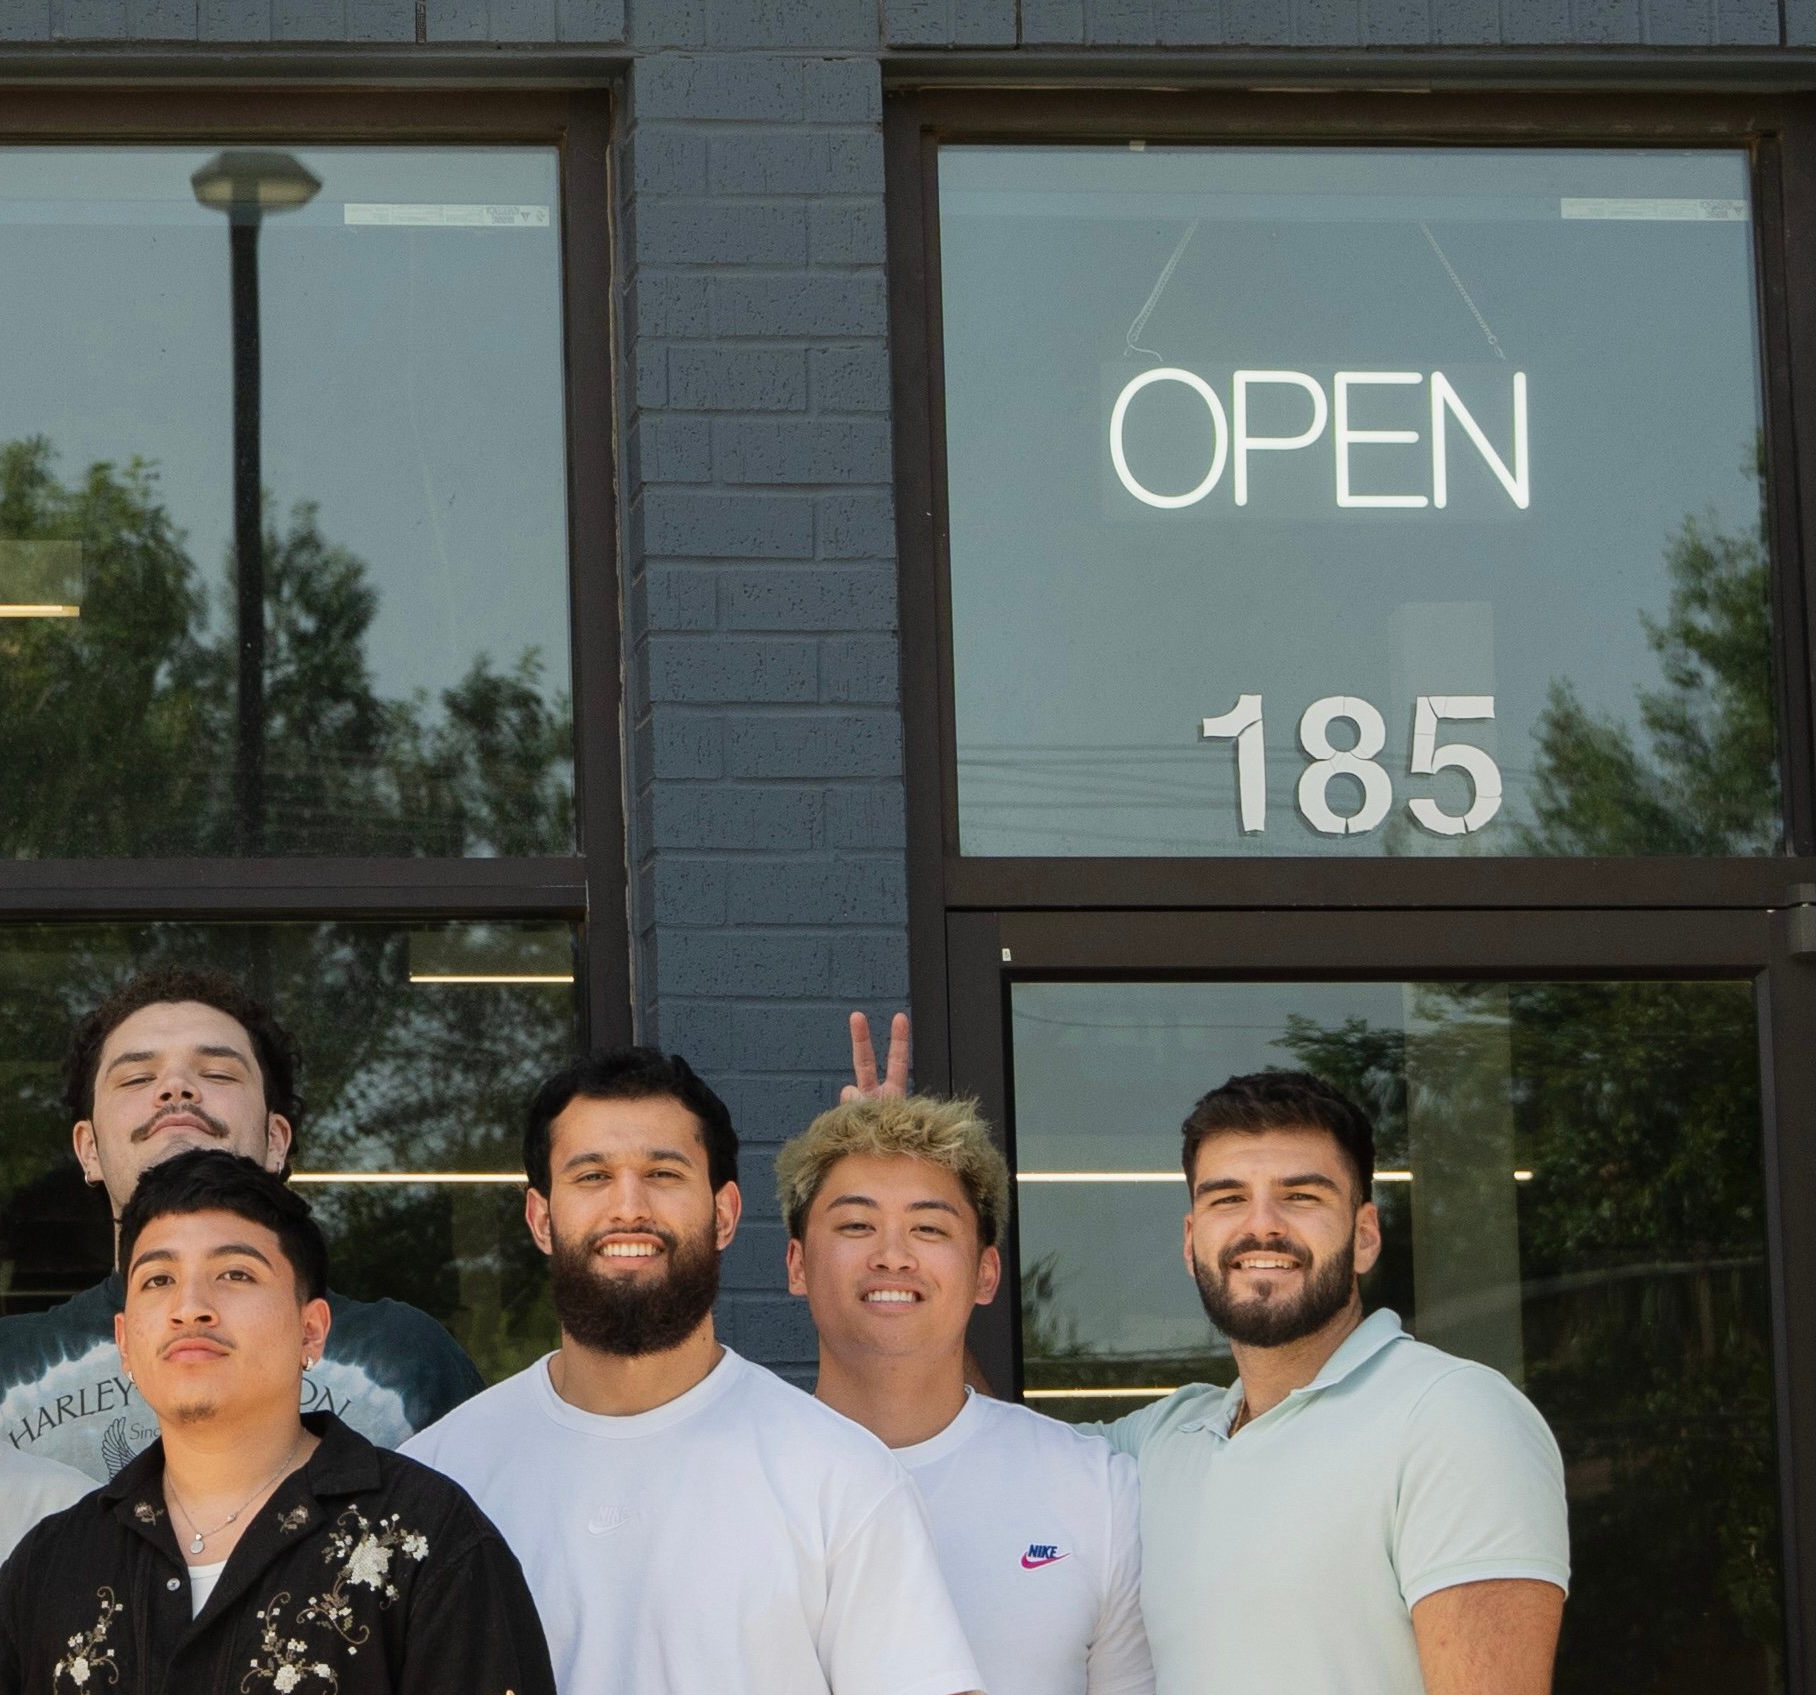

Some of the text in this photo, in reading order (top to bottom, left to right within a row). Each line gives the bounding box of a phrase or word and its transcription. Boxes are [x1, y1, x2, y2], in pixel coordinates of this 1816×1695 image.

[1111, 369, 1528, 508] OPEN
[1203, 695, 1501, 834] 185
[1028, 1544, 1058, 1559] NIKE
